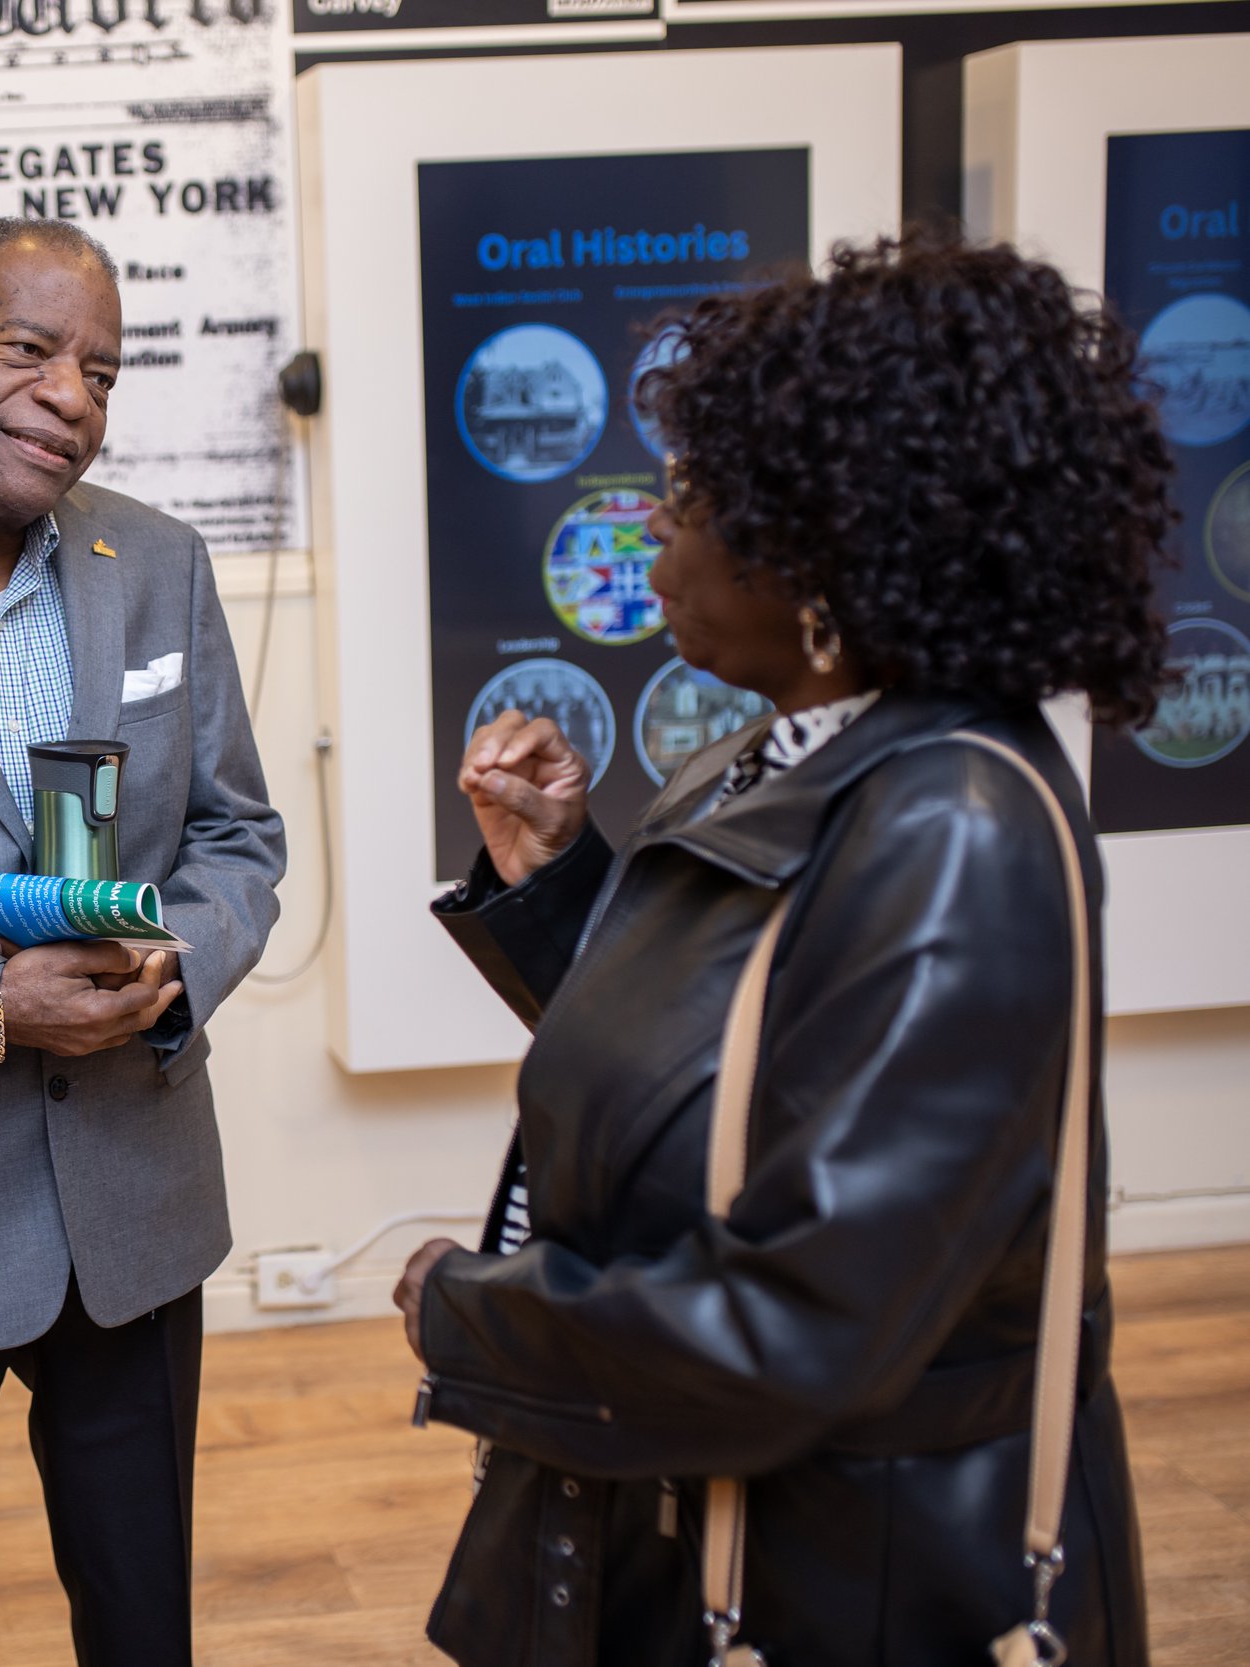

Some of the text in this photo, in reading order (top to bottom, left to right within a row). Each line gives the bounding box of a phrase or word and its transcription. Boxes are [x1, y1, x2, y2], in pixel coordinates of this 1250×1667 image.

[24, 185, 123, 218] NEW
[151, 177, 275, 215] YORK
[1159, 200, 1240, 240] Oral
[478, 223, 750, 271] Oral Histories
[126, 261, 184, 280] Race
[10, 889, 23, 917] Hartford
[19, 917, 28, 929] City
[17, 880, 27, 907] Windsor
